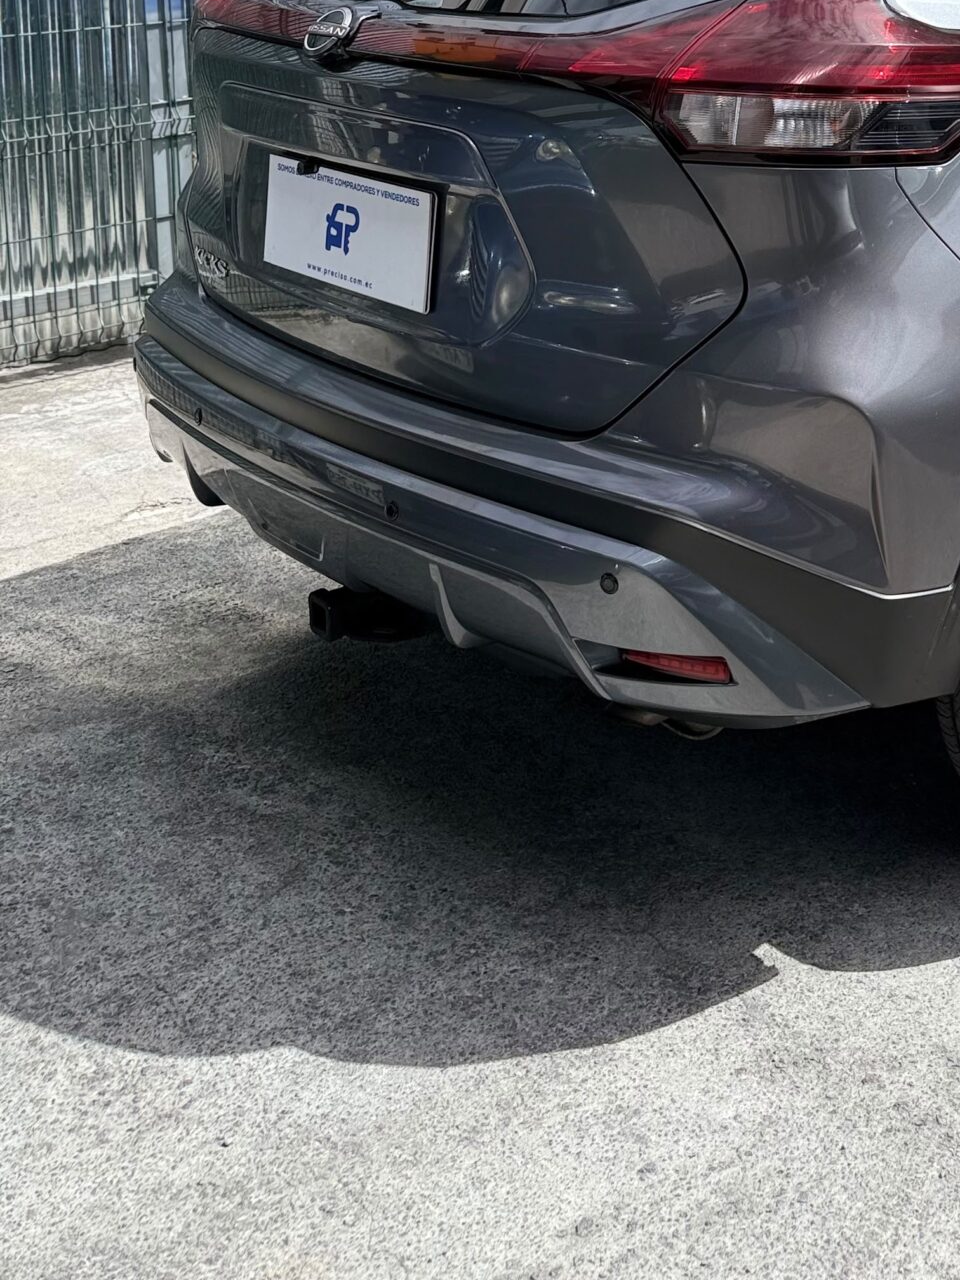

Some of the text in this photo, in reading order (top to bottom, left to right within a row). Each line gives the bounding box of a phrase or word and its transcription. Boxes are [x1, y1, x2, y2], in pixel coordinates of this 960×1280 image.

[277, 163, 296, 175] SOMOS
[316, 173, 334, 185] ENTRE
[335, 178, 376, 196] COMPRADORES
[381, 190, 420, 207] VENDEDORES
